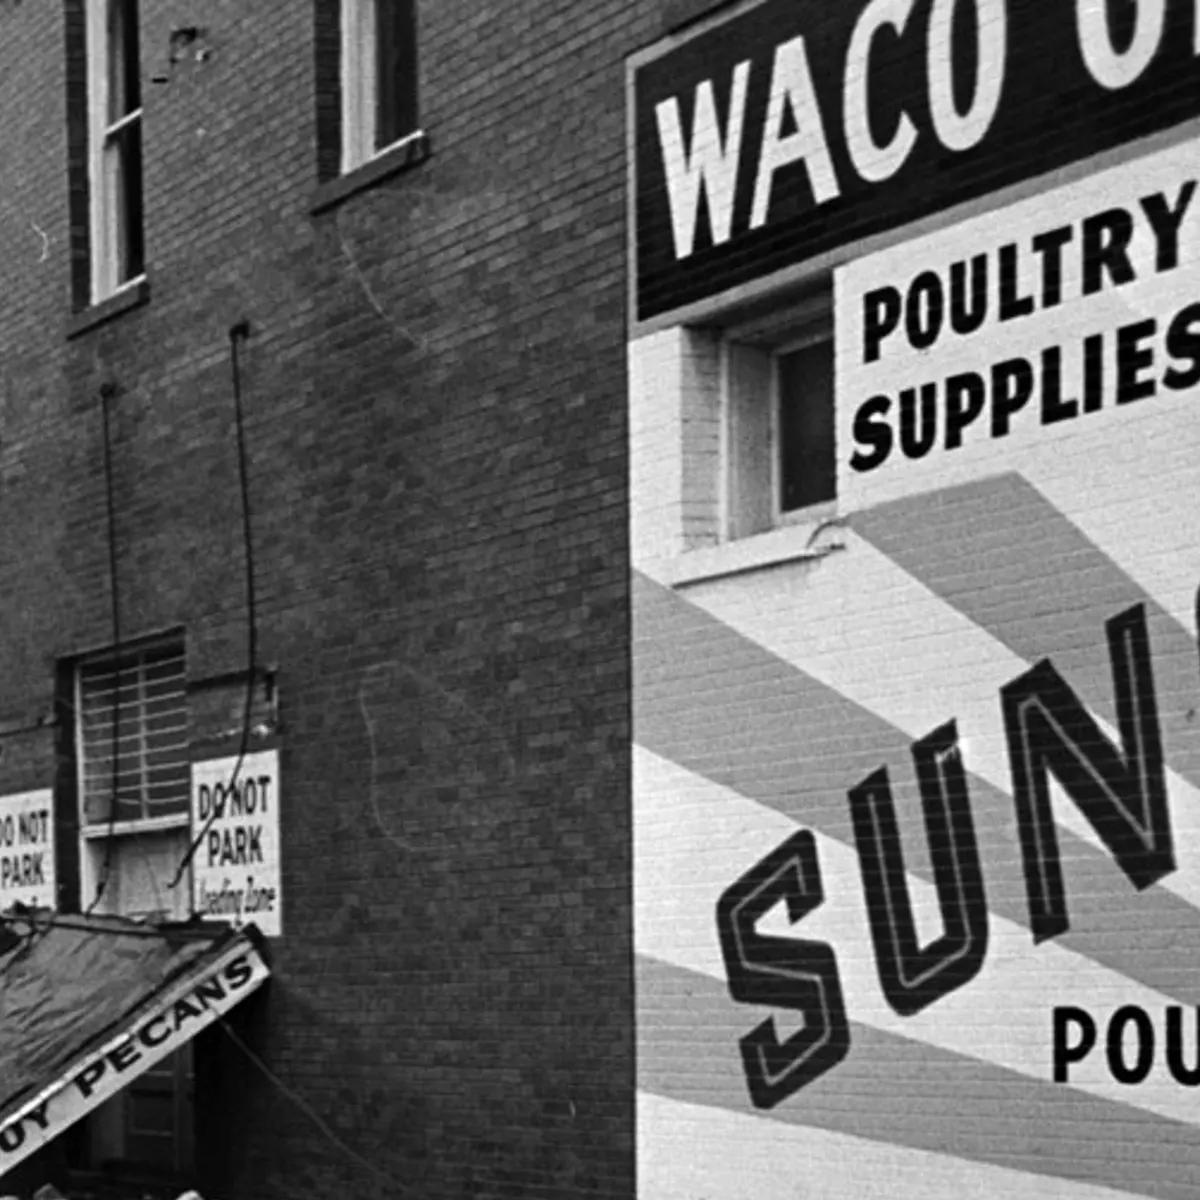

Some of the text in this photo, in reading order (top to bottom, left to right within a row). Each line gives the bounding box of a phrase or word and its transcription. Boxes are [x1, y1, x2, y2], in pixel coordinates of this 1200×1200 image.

[655, 0, 1007, 260] WACO
[863, 179, 1198, 364] POULTRY
[849, 301, 1200, 473] SUPPLIES
[18, 808, 49, 845] NOT
[198, 774, 271, 820] DO NOT
[207, 825, 264, 867] PARK
[716, 590, 1200, 1110] SUN
[1, 852, 45, 890] PARK
[73, 955, 254, 1099] PECANS
